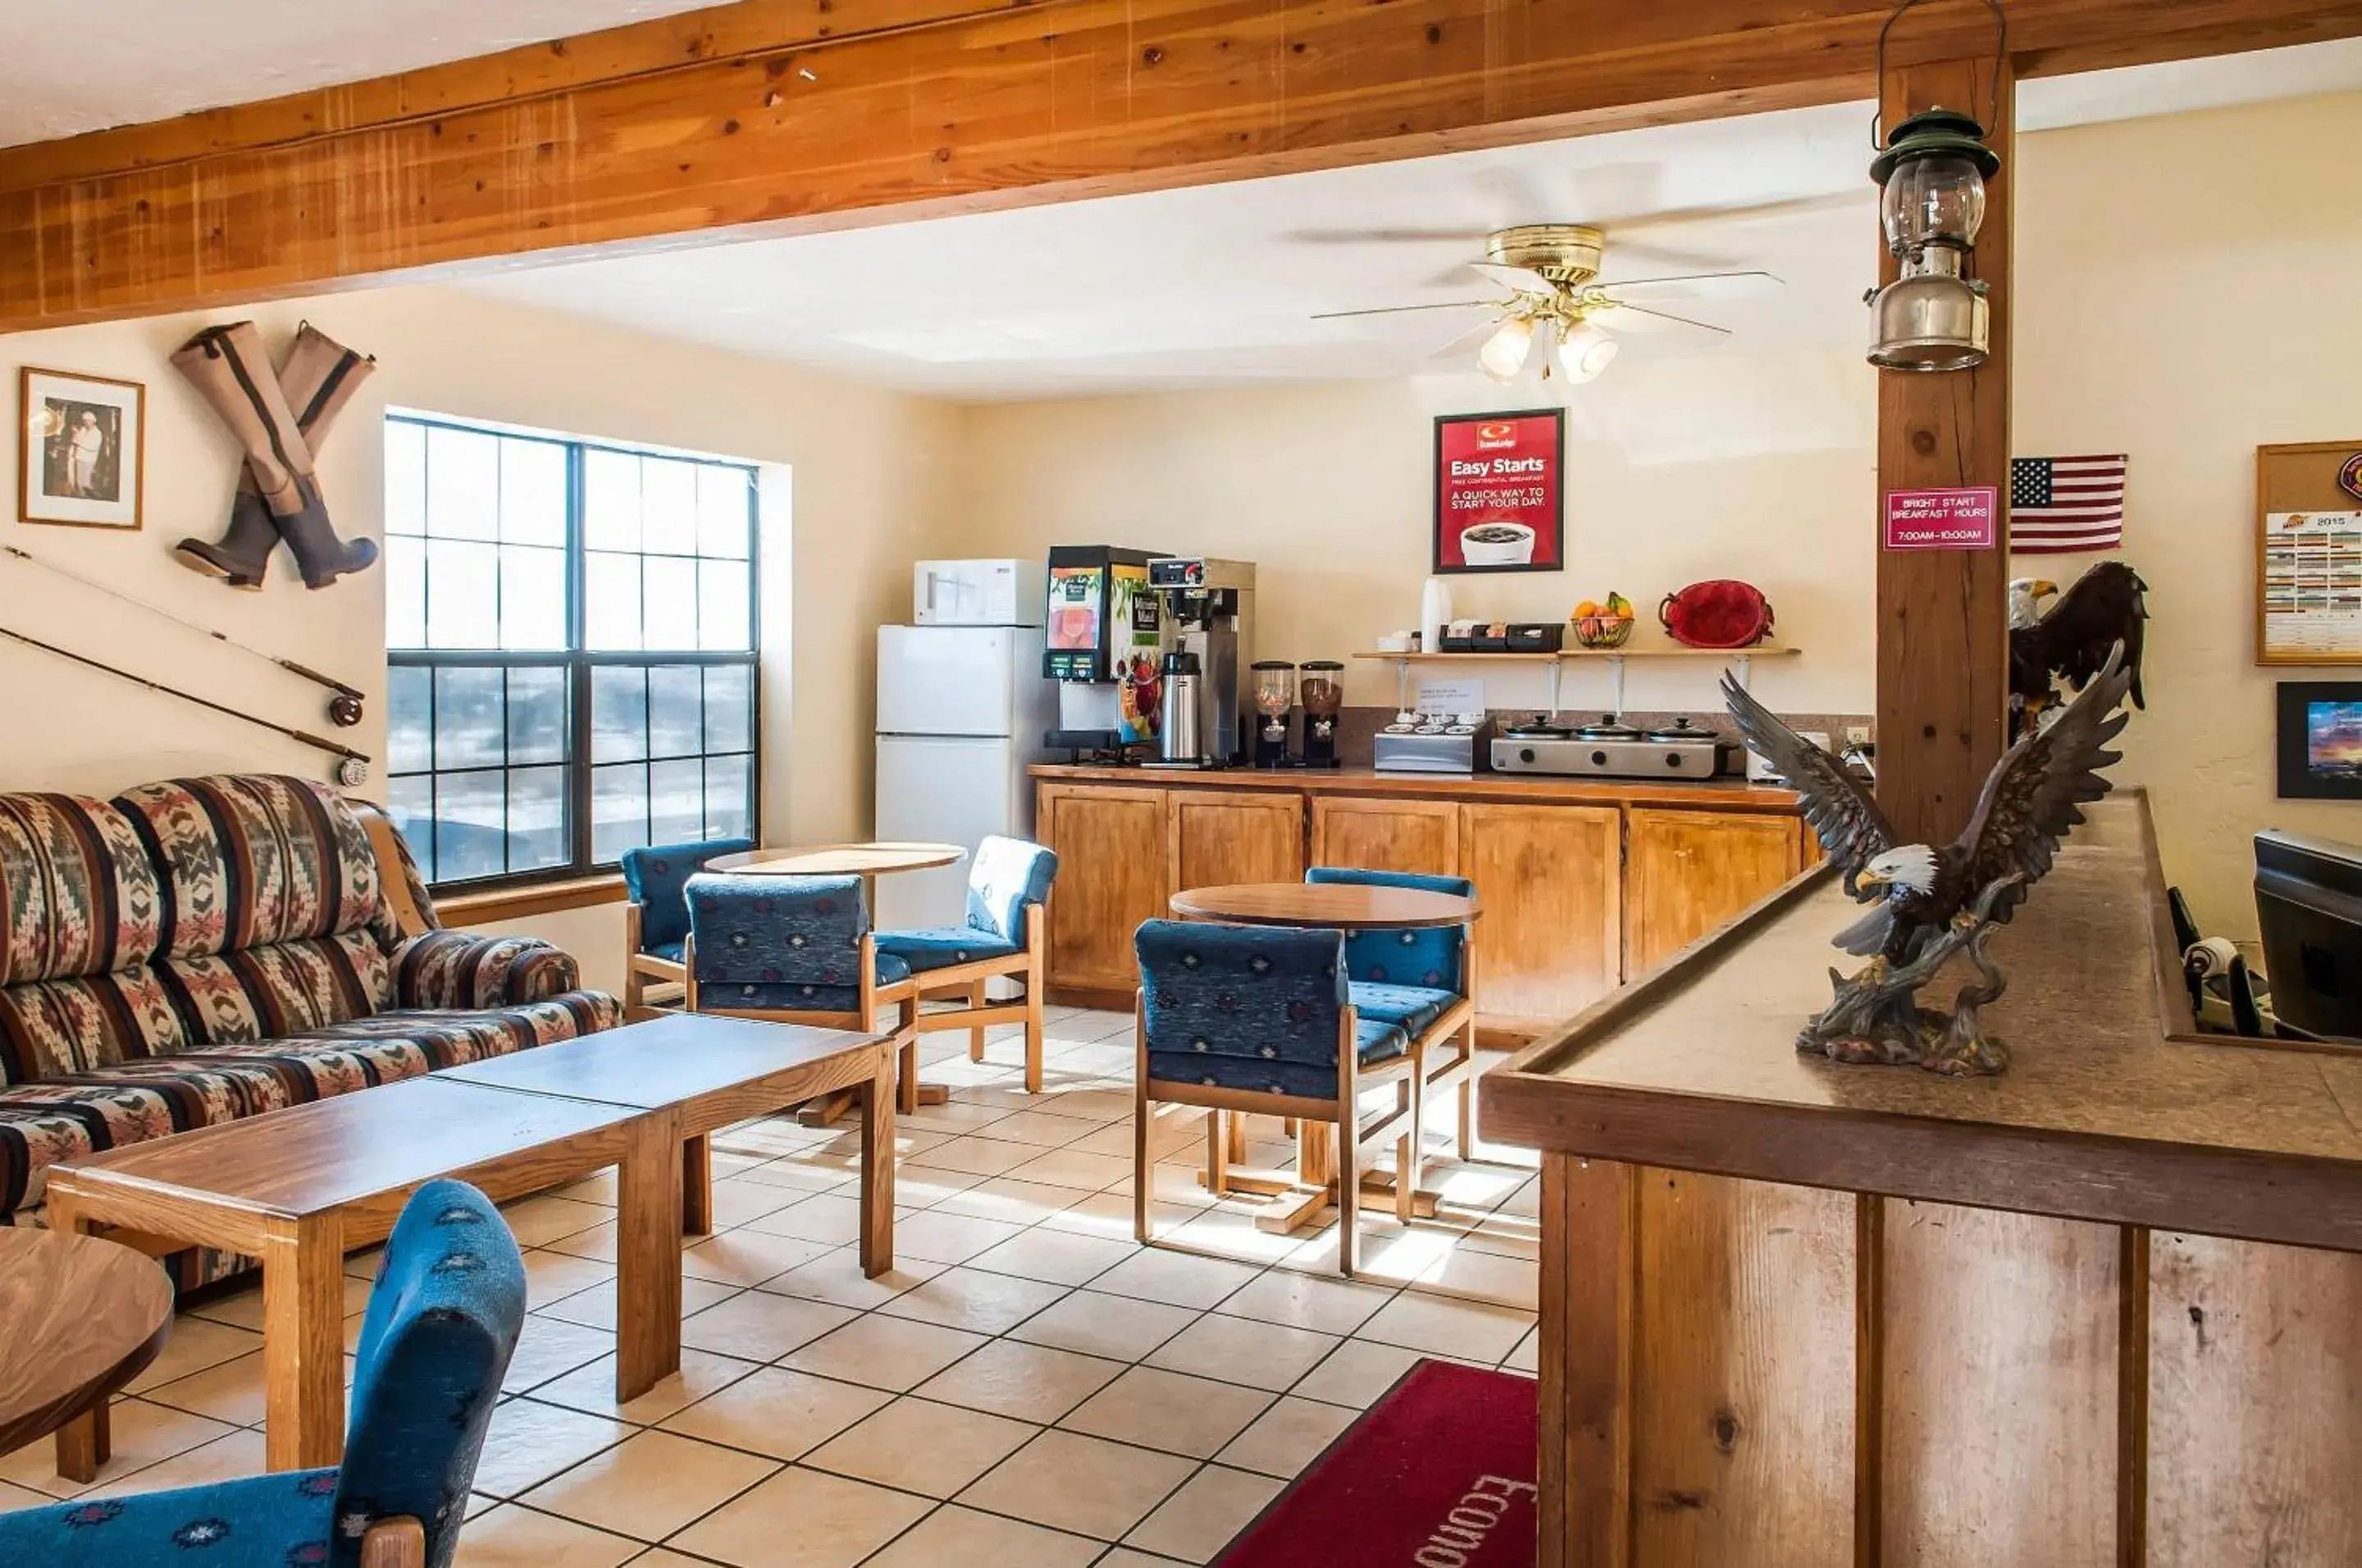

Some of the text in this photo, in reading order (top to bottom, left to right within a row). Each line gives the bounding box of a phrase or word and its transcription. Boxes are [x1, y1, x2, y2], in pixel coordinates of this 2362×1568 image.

[1451, 458, 1544, 477] Easy Starts
[1452, 487, 1544, 500] A QUICK WAY TO
[1451, 496, 1546, 509] START YOUR DAY.
[1903, 497, 1976, 508] BRIGHT START
[1892, 507, 1988, 520] BREAKFAST HOURS
[2317, 517, 2346, 526] 2015
[1414, 1475, 1538, 1568] Econo
